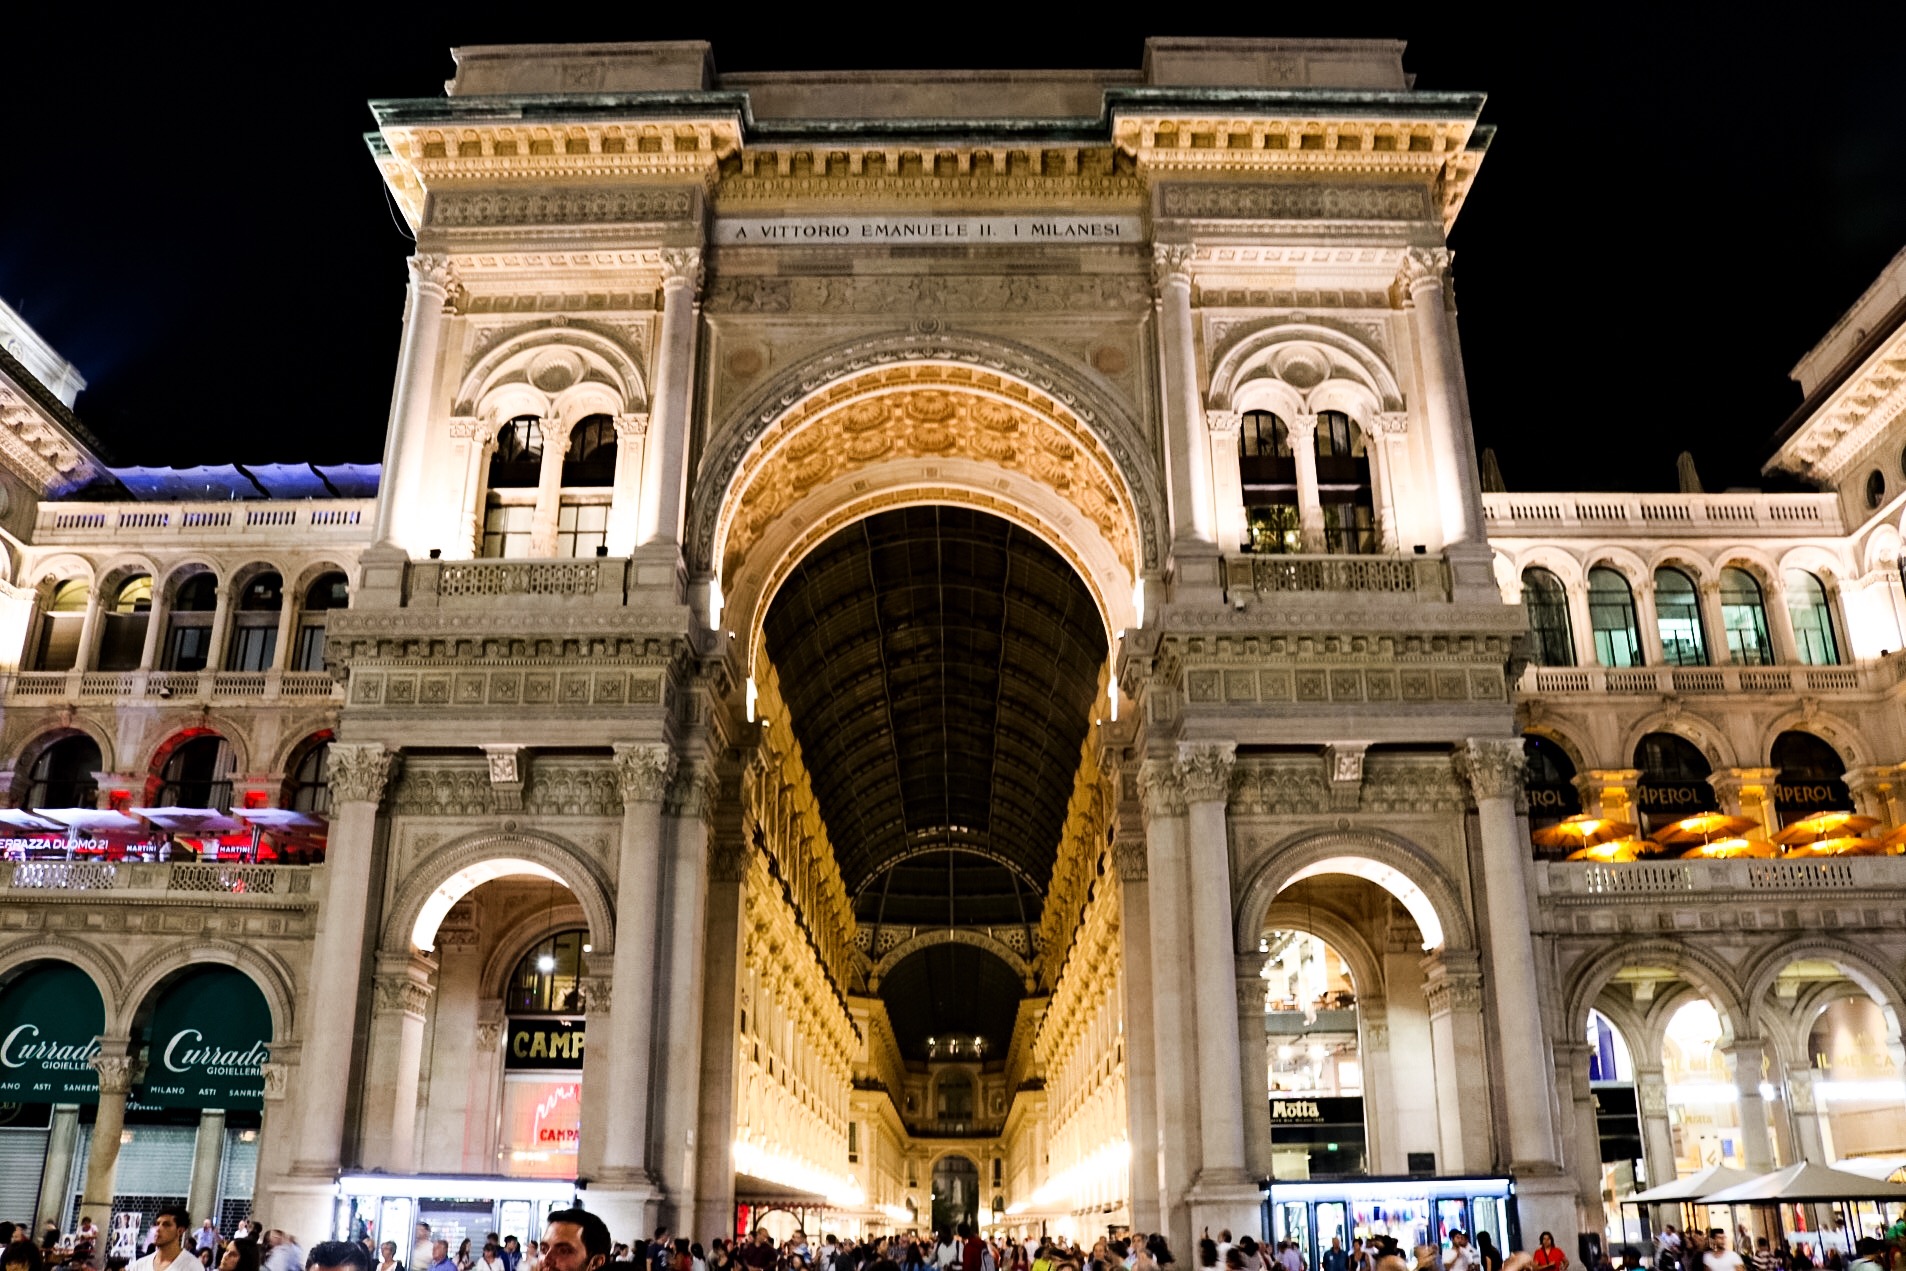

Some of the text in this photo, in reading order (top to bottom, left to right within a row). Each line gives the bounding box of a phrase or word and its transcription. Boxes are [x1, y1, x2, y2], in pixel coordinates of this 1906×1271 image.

[735, 225, 747, 239] A
[761, 224, 850, 239] VITTORIO
[861, 223, 968, 238] EMANUELE
[1031, 223, 1120, 237] MILANESI
[1637, 785, 1702, 805] APEROL
[1775, 784, 1837, 803] APEROL
[53, 838, 97, 850] DUOMO
[97, 839, 109, 850] 21
[126, 844, 157, 853] MARTINI
[220, 845, 250, 854] MARTINI
[163, 1028, 269, 1073] Currado
[33, 1082, 52, 1092] ASTI
[150, 1085, 185, 1095] MILANO
[198, 1087, 217, 1096] ASTI
[1272, 1100, 1320, 1118] Motta
